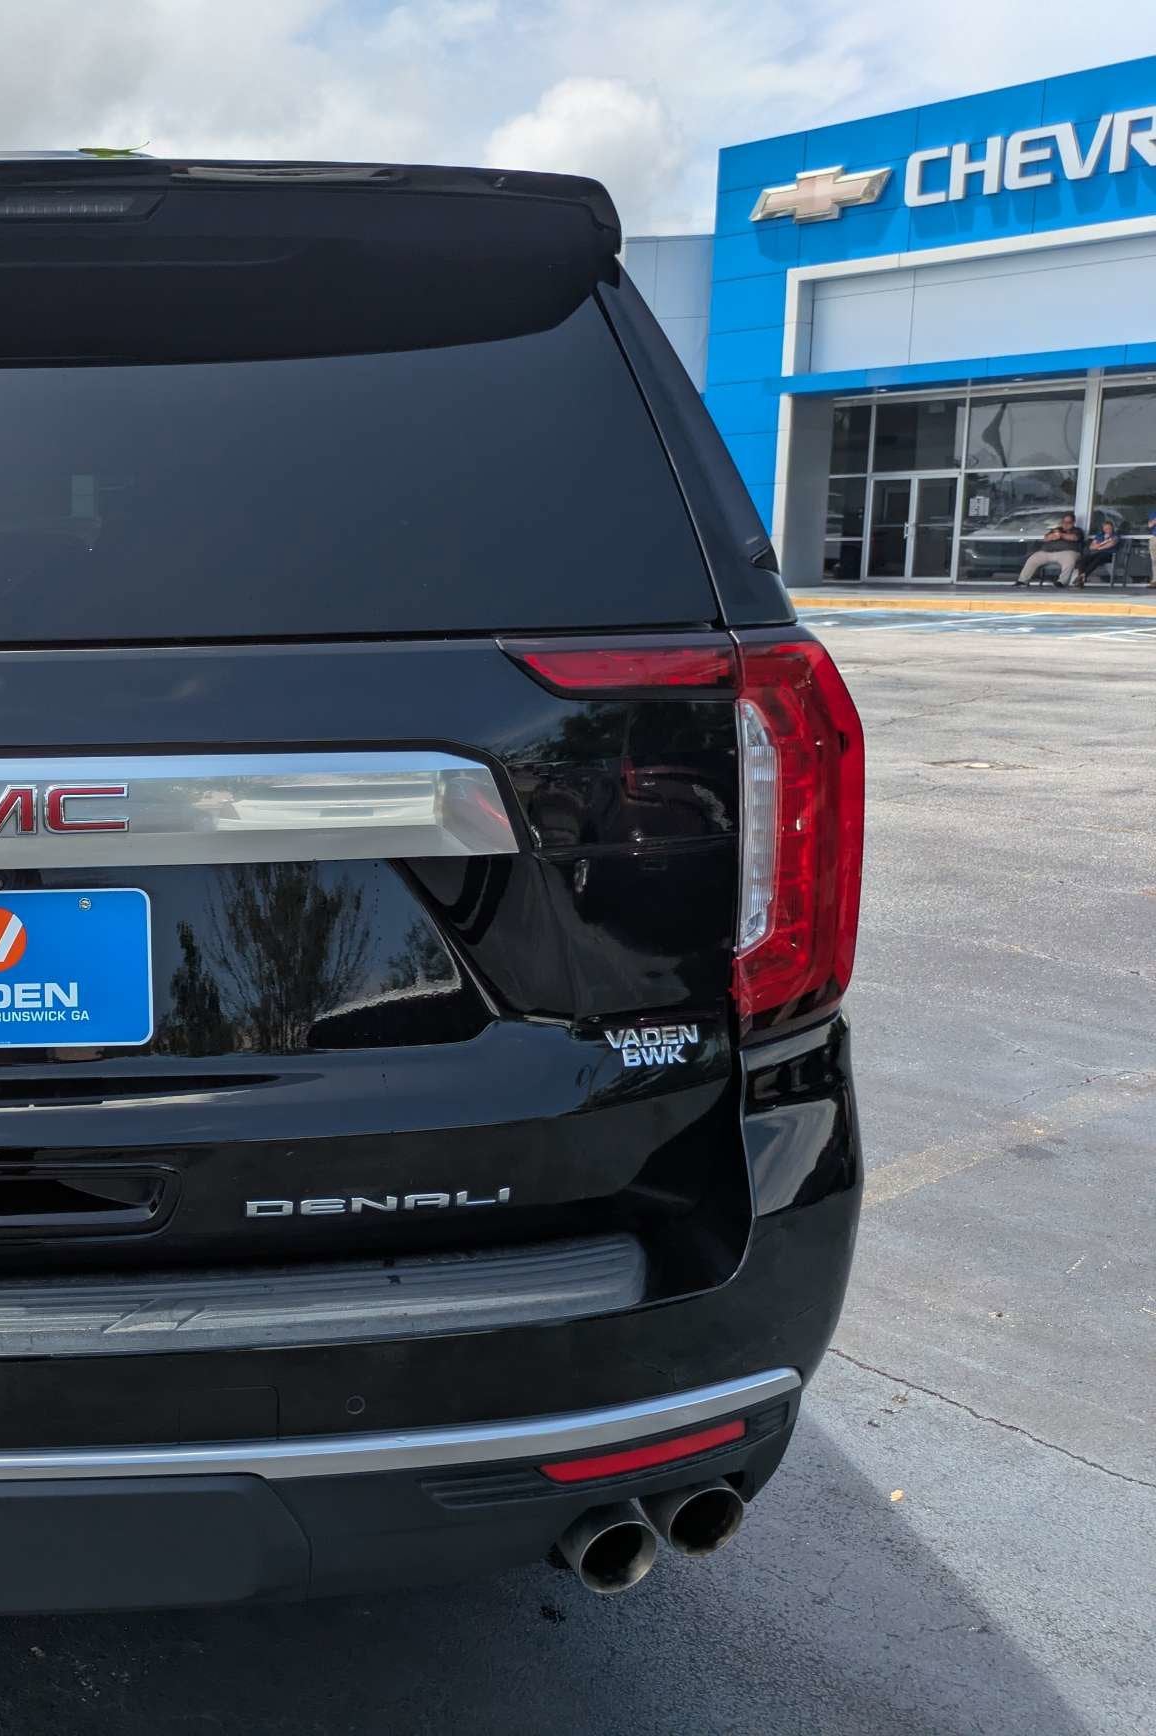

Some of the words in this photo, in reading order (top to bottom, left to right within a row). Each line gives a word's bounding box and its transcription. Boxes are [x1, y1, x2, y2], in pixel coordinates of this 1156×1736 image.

[904, 105, 1156, 208] CHEVR
[70, 1010, 90, 1021] GA
[604, 1024, 699, 1049] VADEN
[622, 1045, 687, 1067] BWK
[246, 1187, 510, 1217] DENALI
